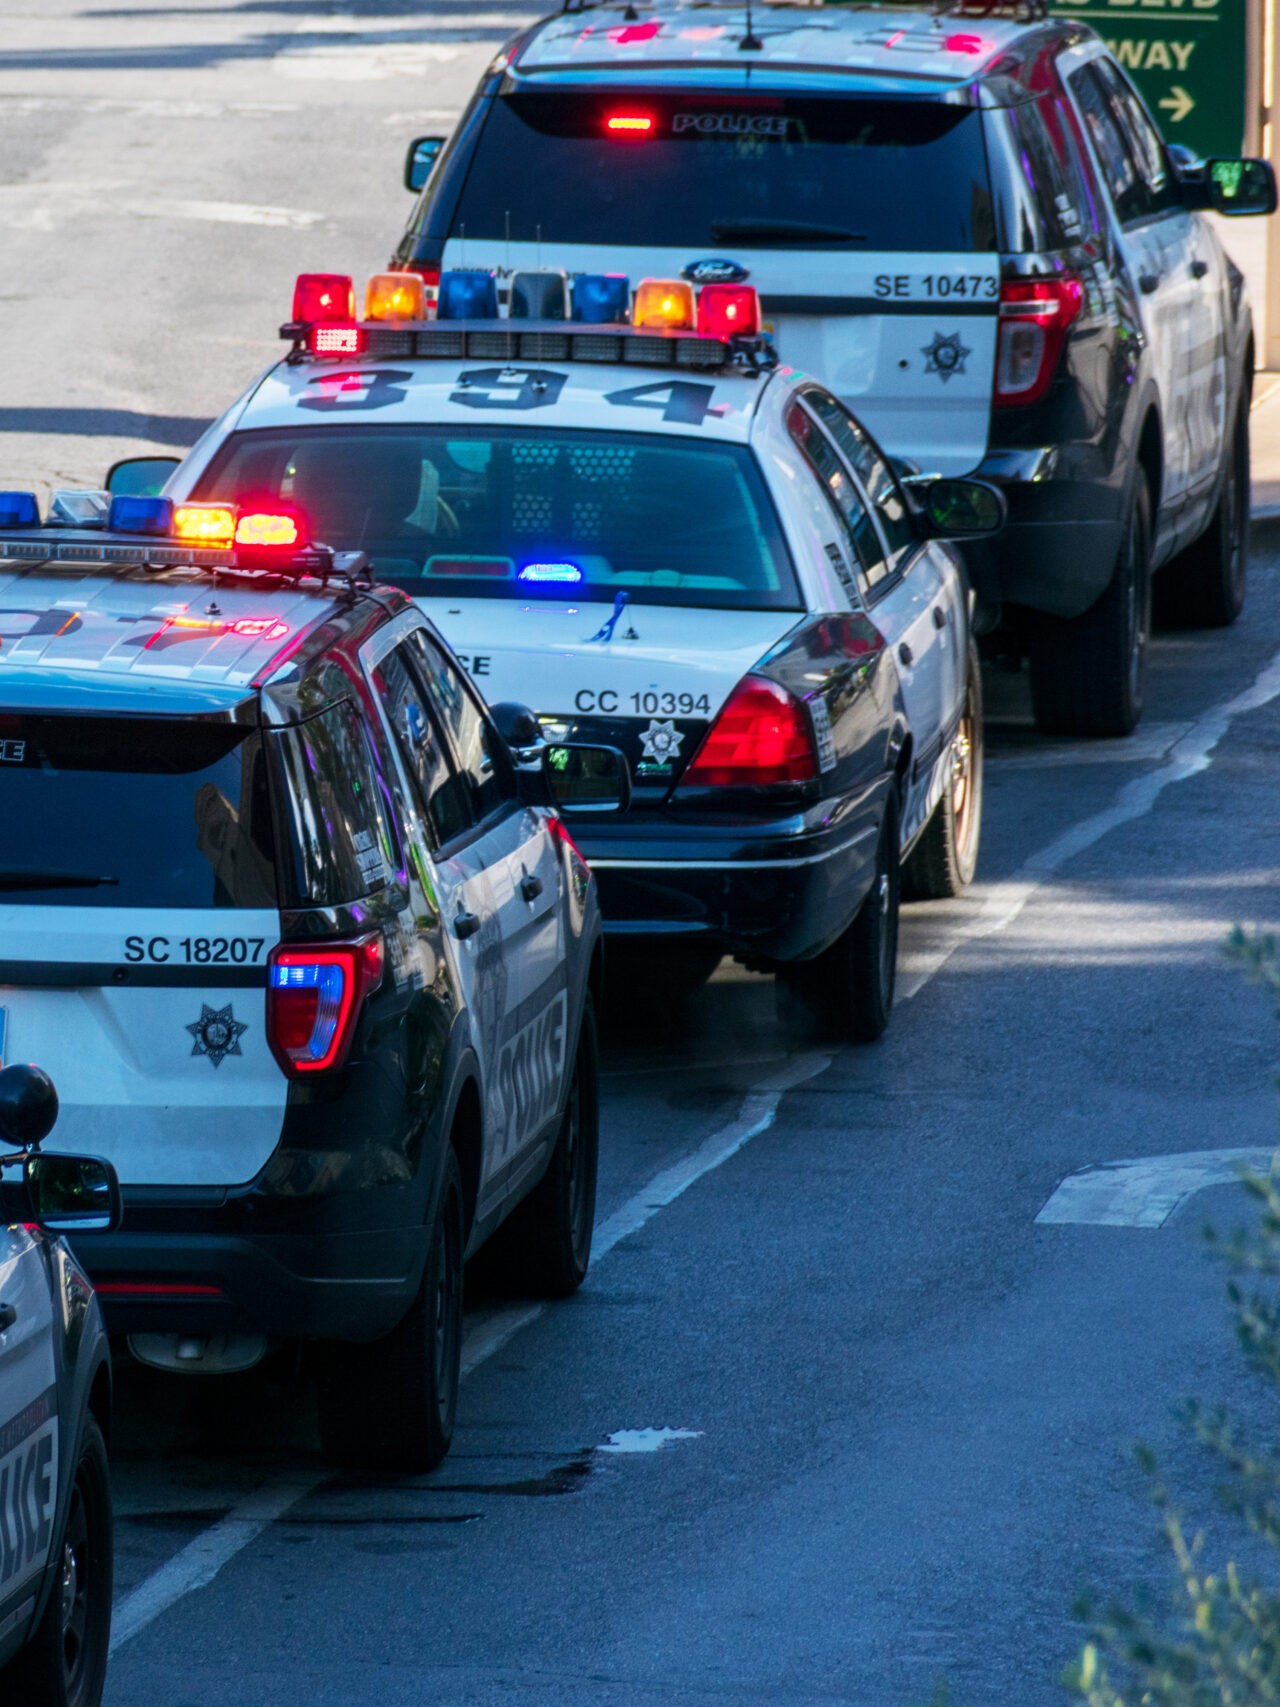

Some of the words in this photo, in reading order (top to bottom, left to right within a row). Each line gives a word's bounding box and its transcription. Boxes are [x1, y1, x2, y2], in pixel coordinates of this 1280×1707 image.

[672, 113, 789, 135] POLICE
[874, 275, 910, 297] SE
[922, 275, 999, 297] 10473
[296, 368, 725, 427] 394
[574, 689, 619, 713] CC
[629, 692, 711, 715] 10394
[124, 935, 170, 962] SC
[179, 937, 265, 963] 18207
